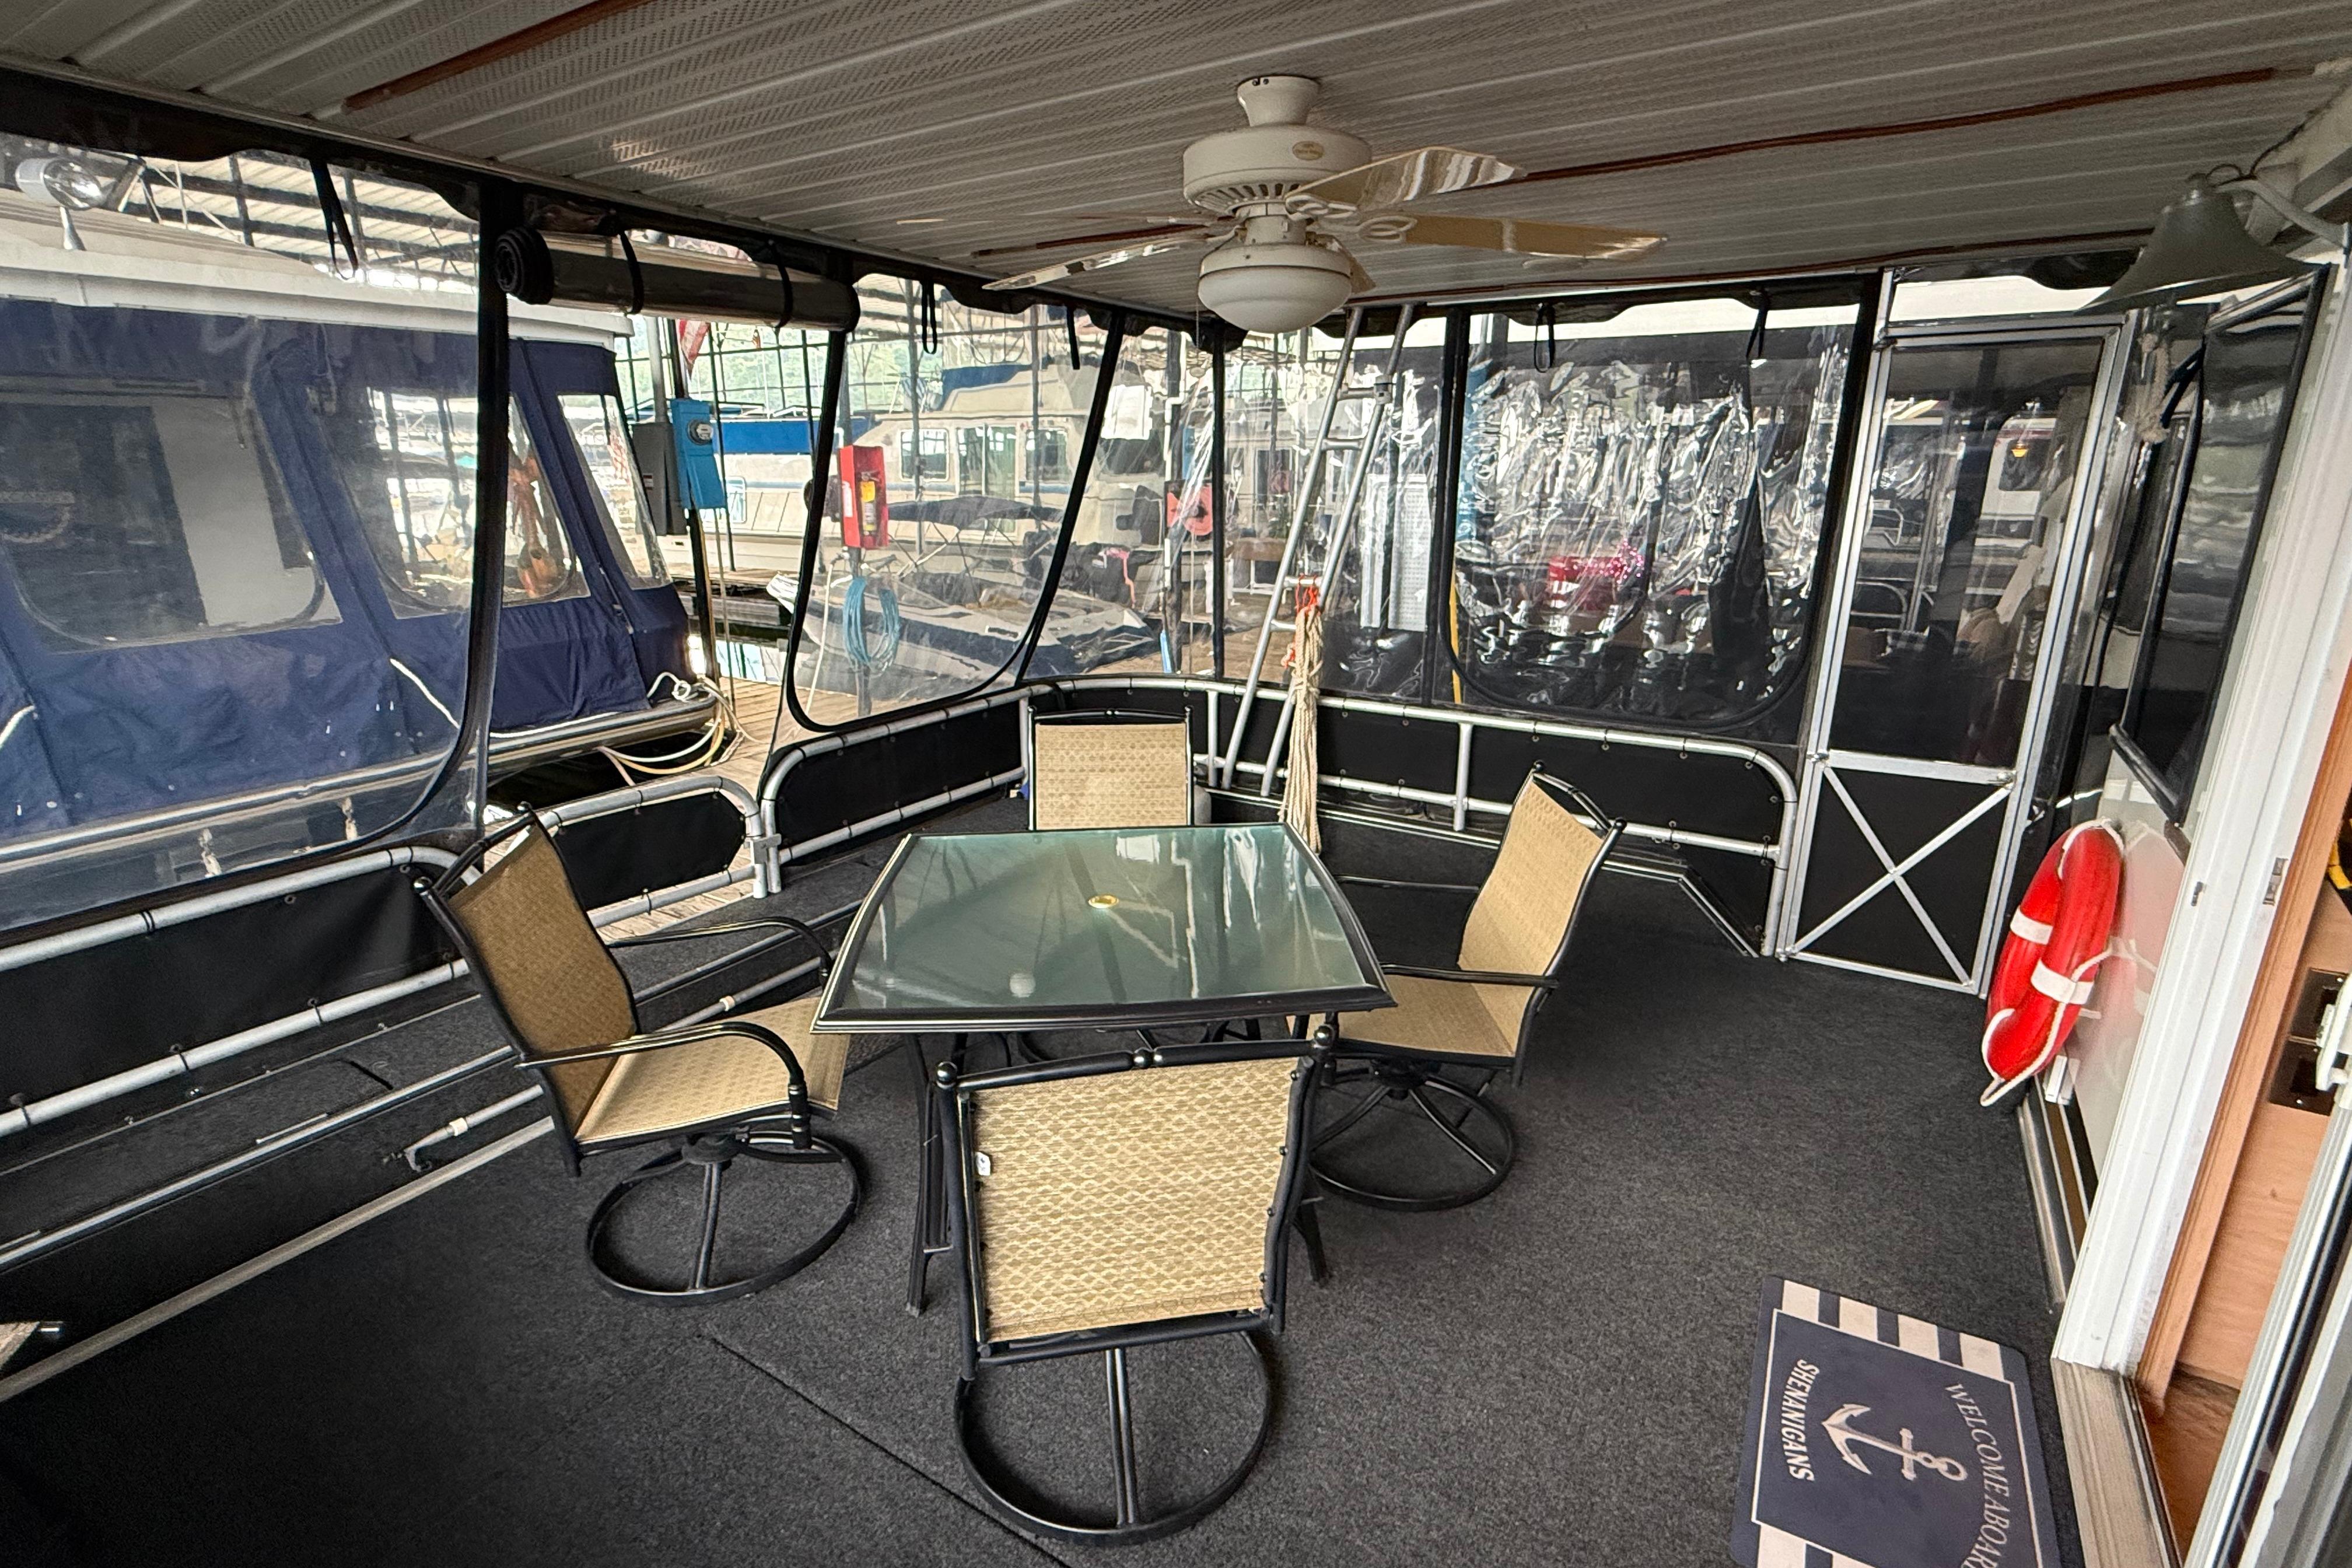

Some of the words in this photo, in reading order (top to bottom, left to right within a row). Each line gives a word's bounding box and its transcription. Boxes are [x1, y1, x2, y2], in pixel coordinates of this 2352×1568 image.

[1782, 1359, 1820, 1481] SHENANIGANS
[1945, 1384, 2010, 1497] WELCOME
[1961, 1493, 2010, 1568] ABOAR
